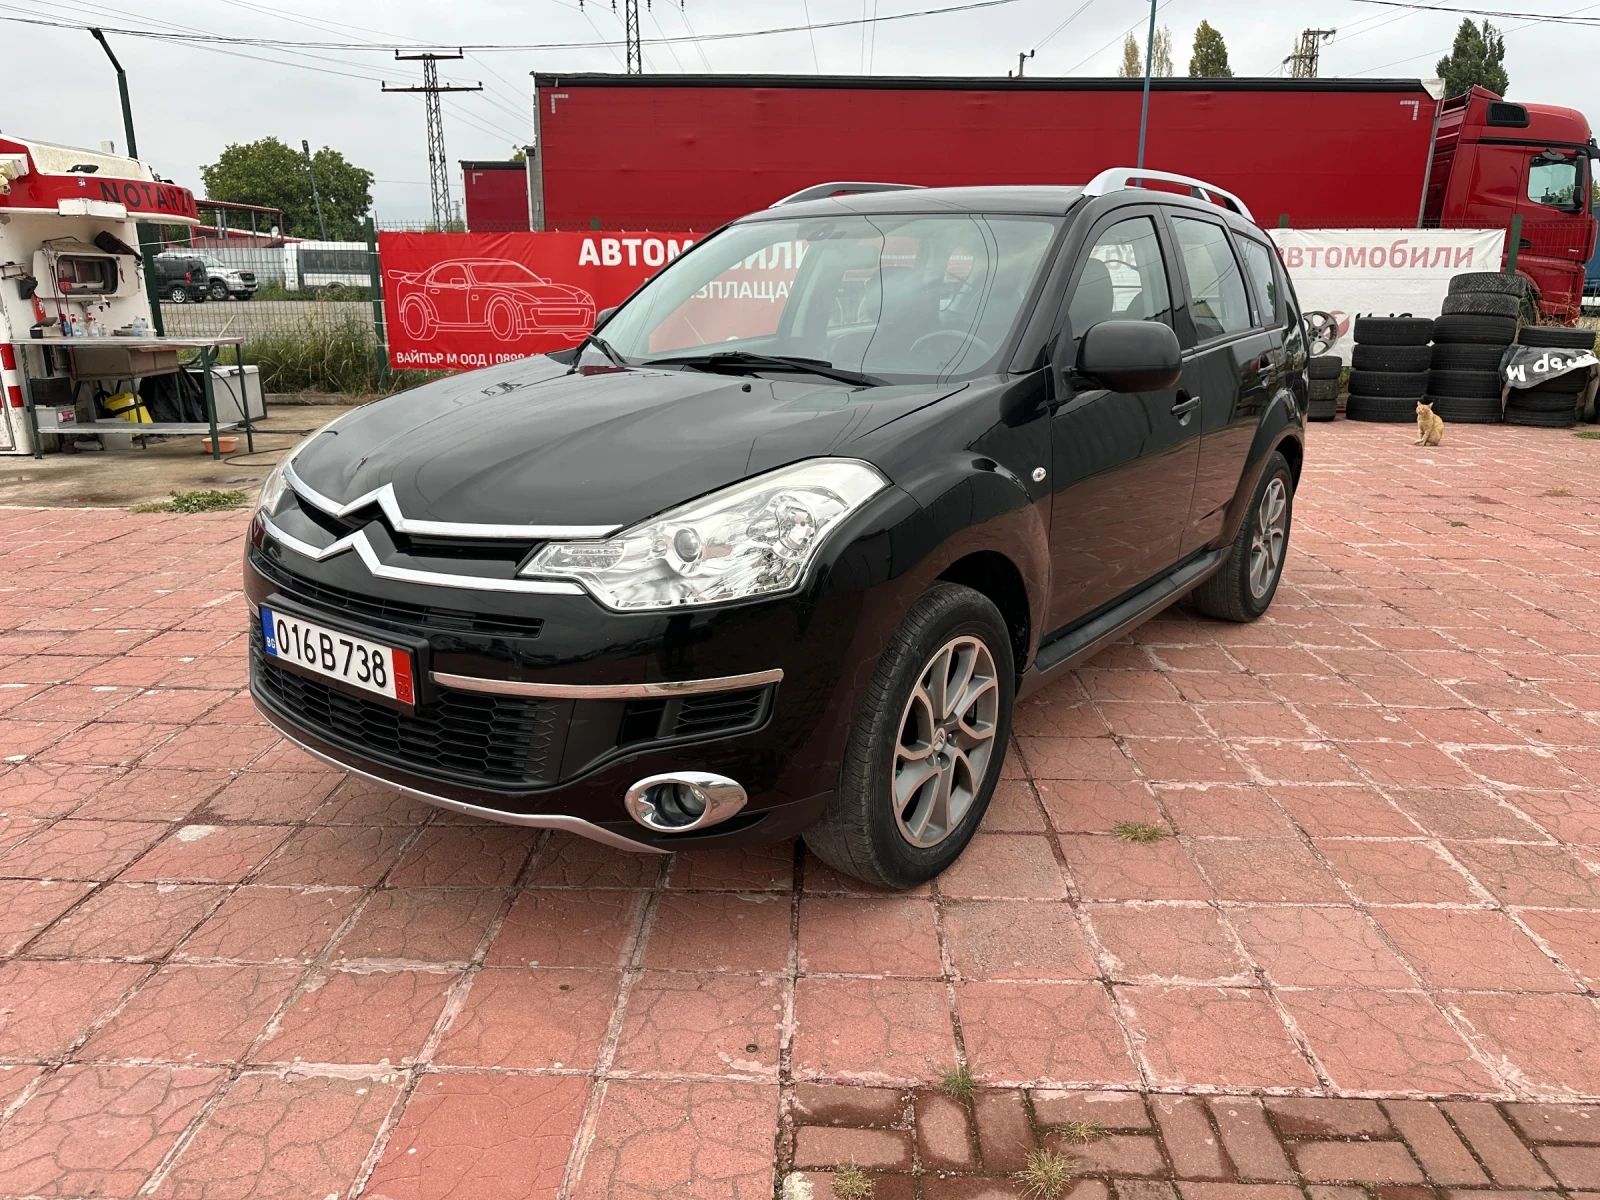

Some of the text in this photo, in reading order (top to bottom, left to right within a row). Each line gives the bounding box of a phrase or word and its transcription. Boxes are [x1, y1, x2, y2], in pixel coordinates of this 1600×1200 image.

[578, 238, 809, 270] АВТОМИЛ
[690, 281, 793, 303] ЗПЛАЩА
[396, 350, 443, 364] ВАЙПЪР
[461, 353, 487, 367] ООД
[266, 636, 276, 649] BG
